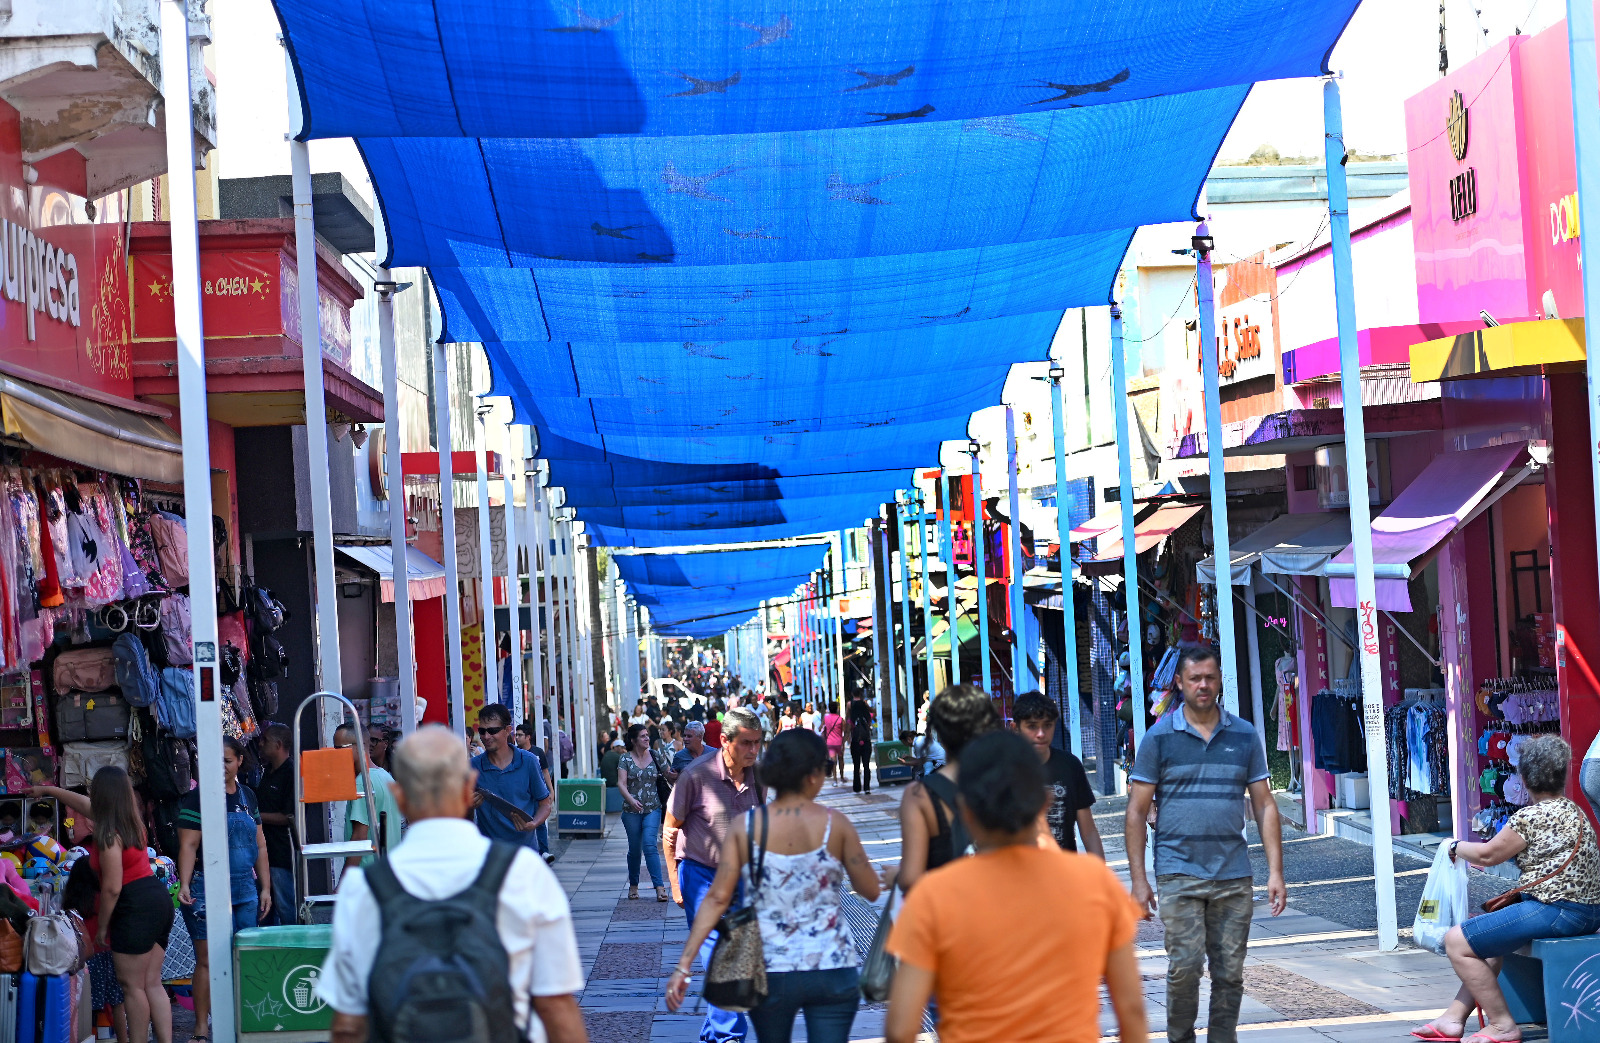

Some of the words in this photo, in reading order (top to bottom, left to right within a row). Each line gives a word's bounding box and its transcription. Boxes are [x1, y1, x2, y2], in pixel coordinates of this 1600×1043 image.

[0, 218, 81, 341] urpresa
[215, 276, 249, 297] CHEN
[1386, 624, 1400, 691] pink
